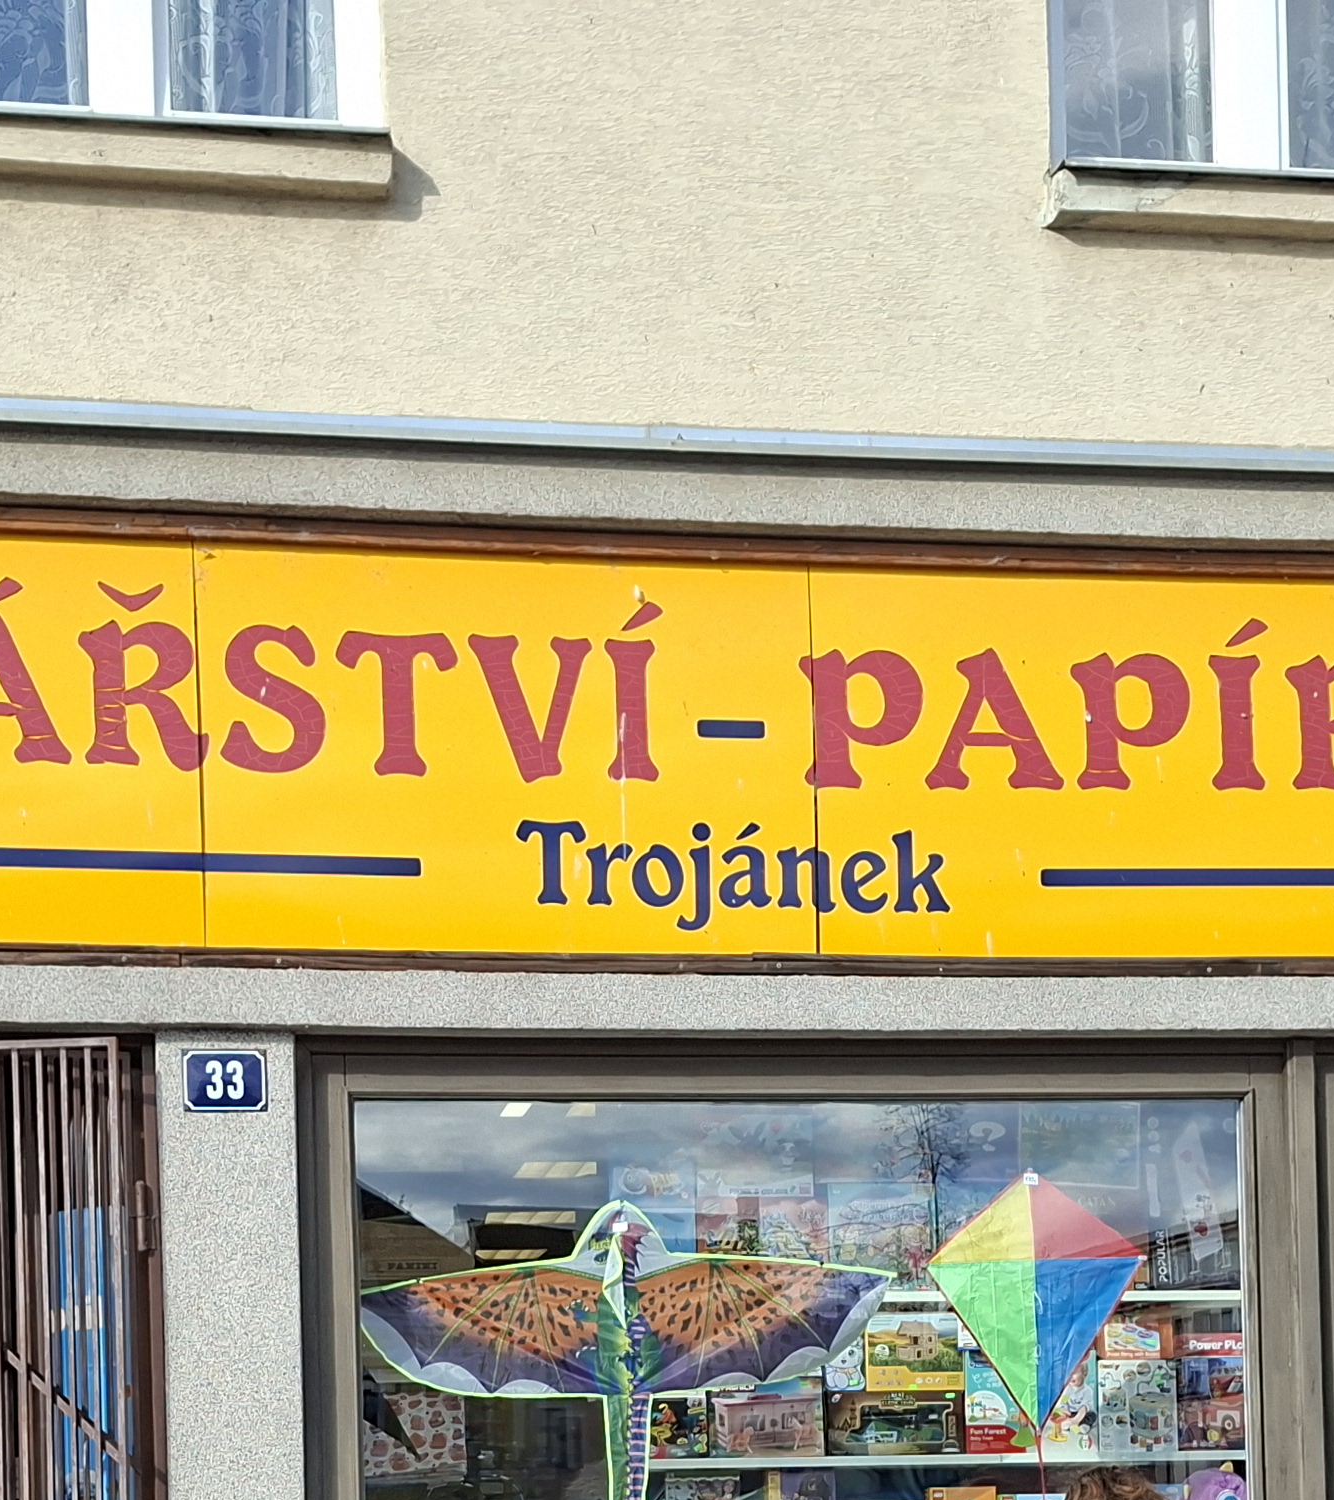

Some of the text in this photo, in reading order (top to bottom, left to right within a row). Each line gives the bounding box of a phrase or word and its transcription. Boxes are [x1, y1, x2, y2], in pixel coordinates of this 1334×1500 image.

[516, 819, 952, 932] Trojánek
[205, 1060, 245, 1100] 33
[1155, 1230, 1169, 1282] POPULAR
